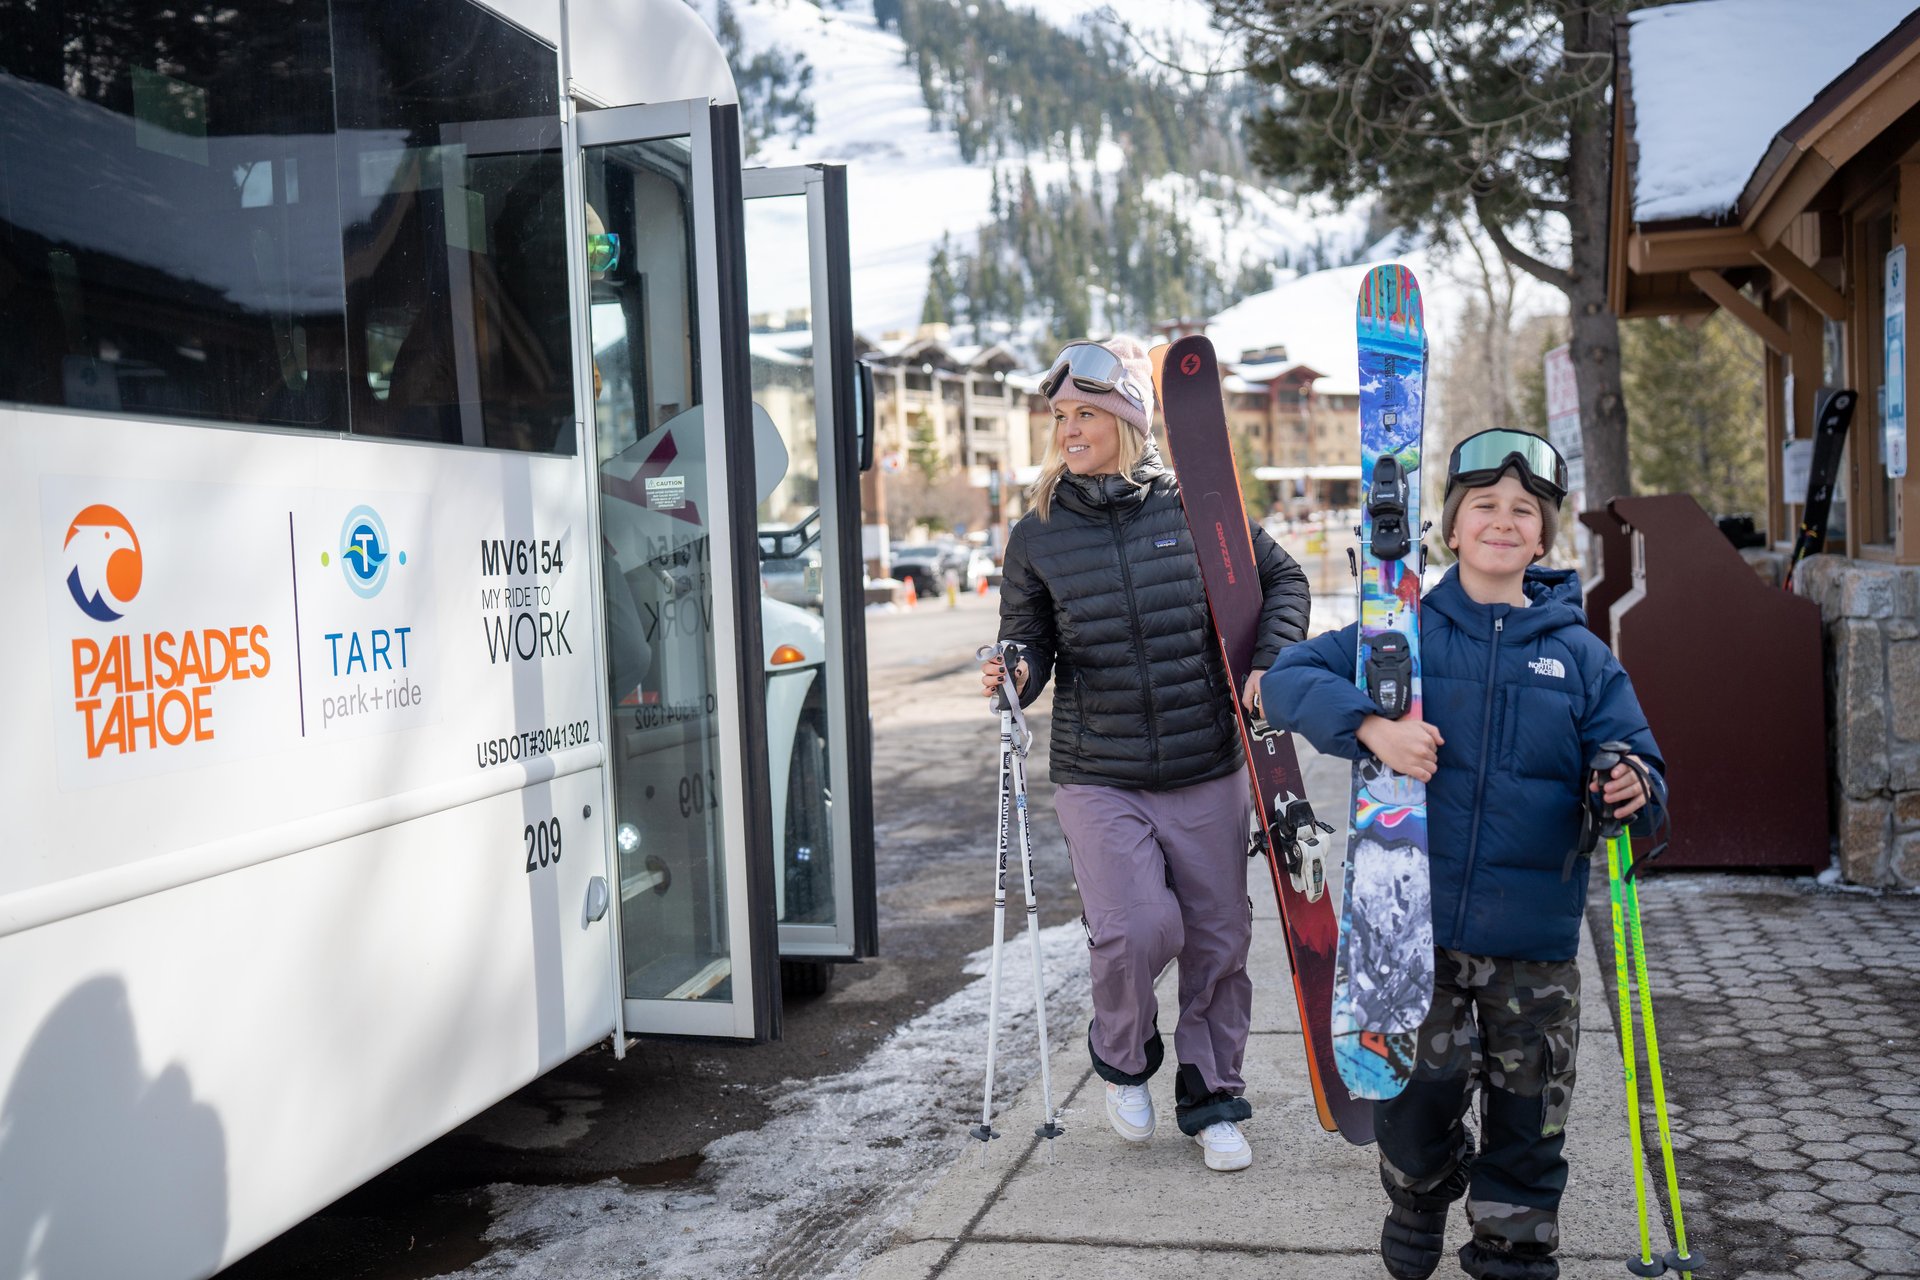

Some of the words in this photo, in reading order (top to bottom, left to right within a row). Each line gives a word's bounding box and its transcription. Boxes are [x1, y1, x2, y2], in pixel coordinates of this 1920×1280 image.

[481, 539, 564, 576] MV6154
[1215, 521, 1236, 585] BLIZZARD
[481, 588, 501, 610] MY
[504, 586, 532, 608] RIDE
[533, 585, 551, 606] TO
[71, 624, 271, 699] PALISADES
[324, 627, 412, 677] TART
[483, 609, 573, 665] WORK
[1528, 661, 1554, 670] NORTH
[1534, 669, 1554, 677] FACE
[75, 685, 215, 760] TAHOE
[322, 677, 423, 729] park+ride
[476, 719, 590, 769] USDOT#3041302
[524, 816, 562, 874] 209
